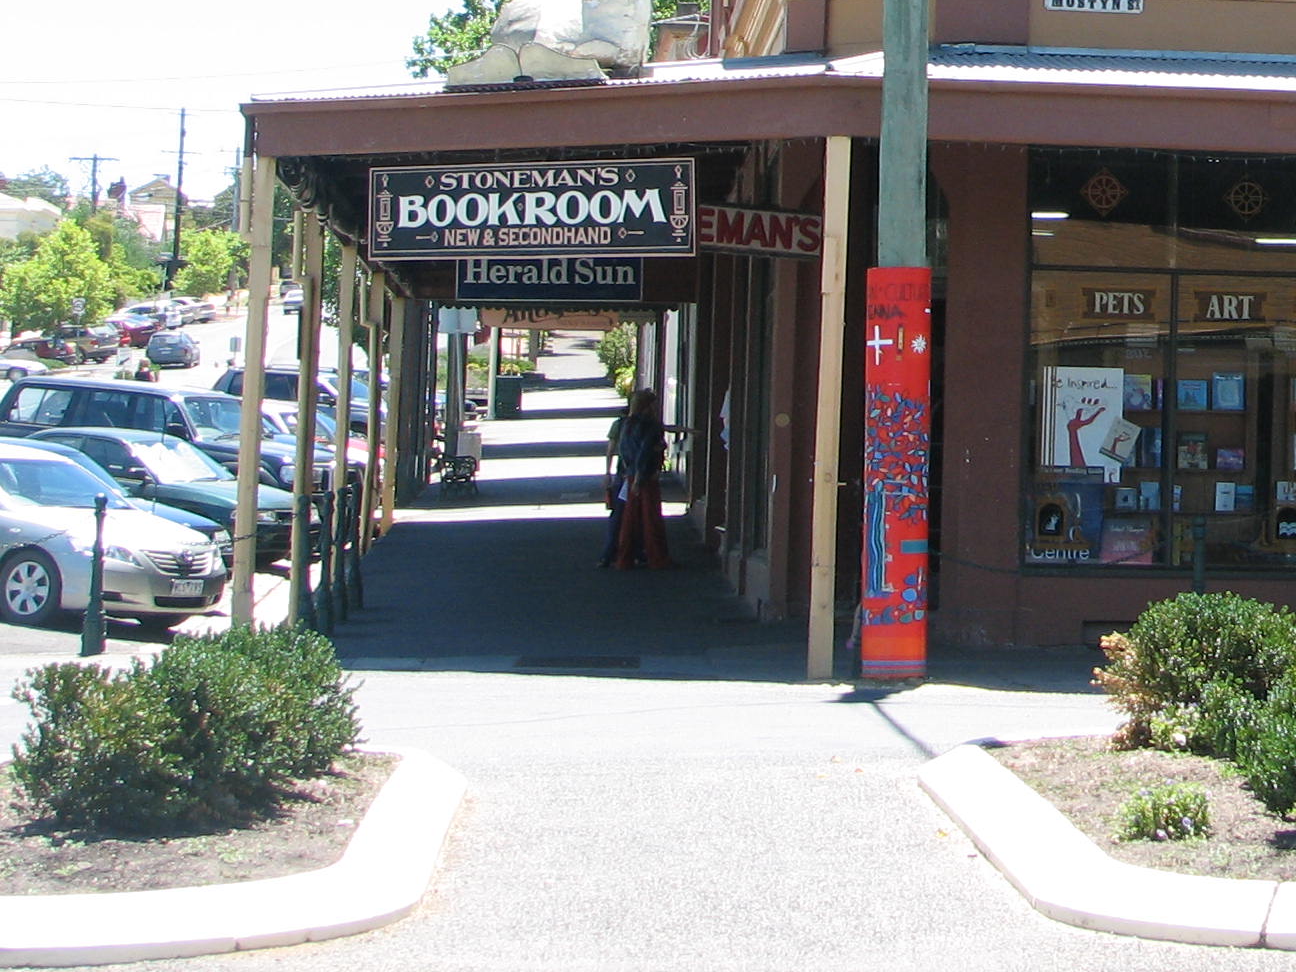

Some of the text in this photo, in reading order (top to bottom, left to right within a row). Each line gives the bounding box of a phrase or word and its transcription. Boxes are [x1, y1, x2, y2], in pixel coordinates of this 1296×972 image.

[439, 166, 620, 190] STONEMAN'S
[397, 188, 668, 229] BOOKROOM
[444, 227, 611, 246] NEW & SECONDHAND
[699, 207, 821, 252] EMAN'S
[463, 258, 636, 285] Herald Sun
[1094, 291, 1145, 315] PETS
[1206, 294, 1255, 320] ART
